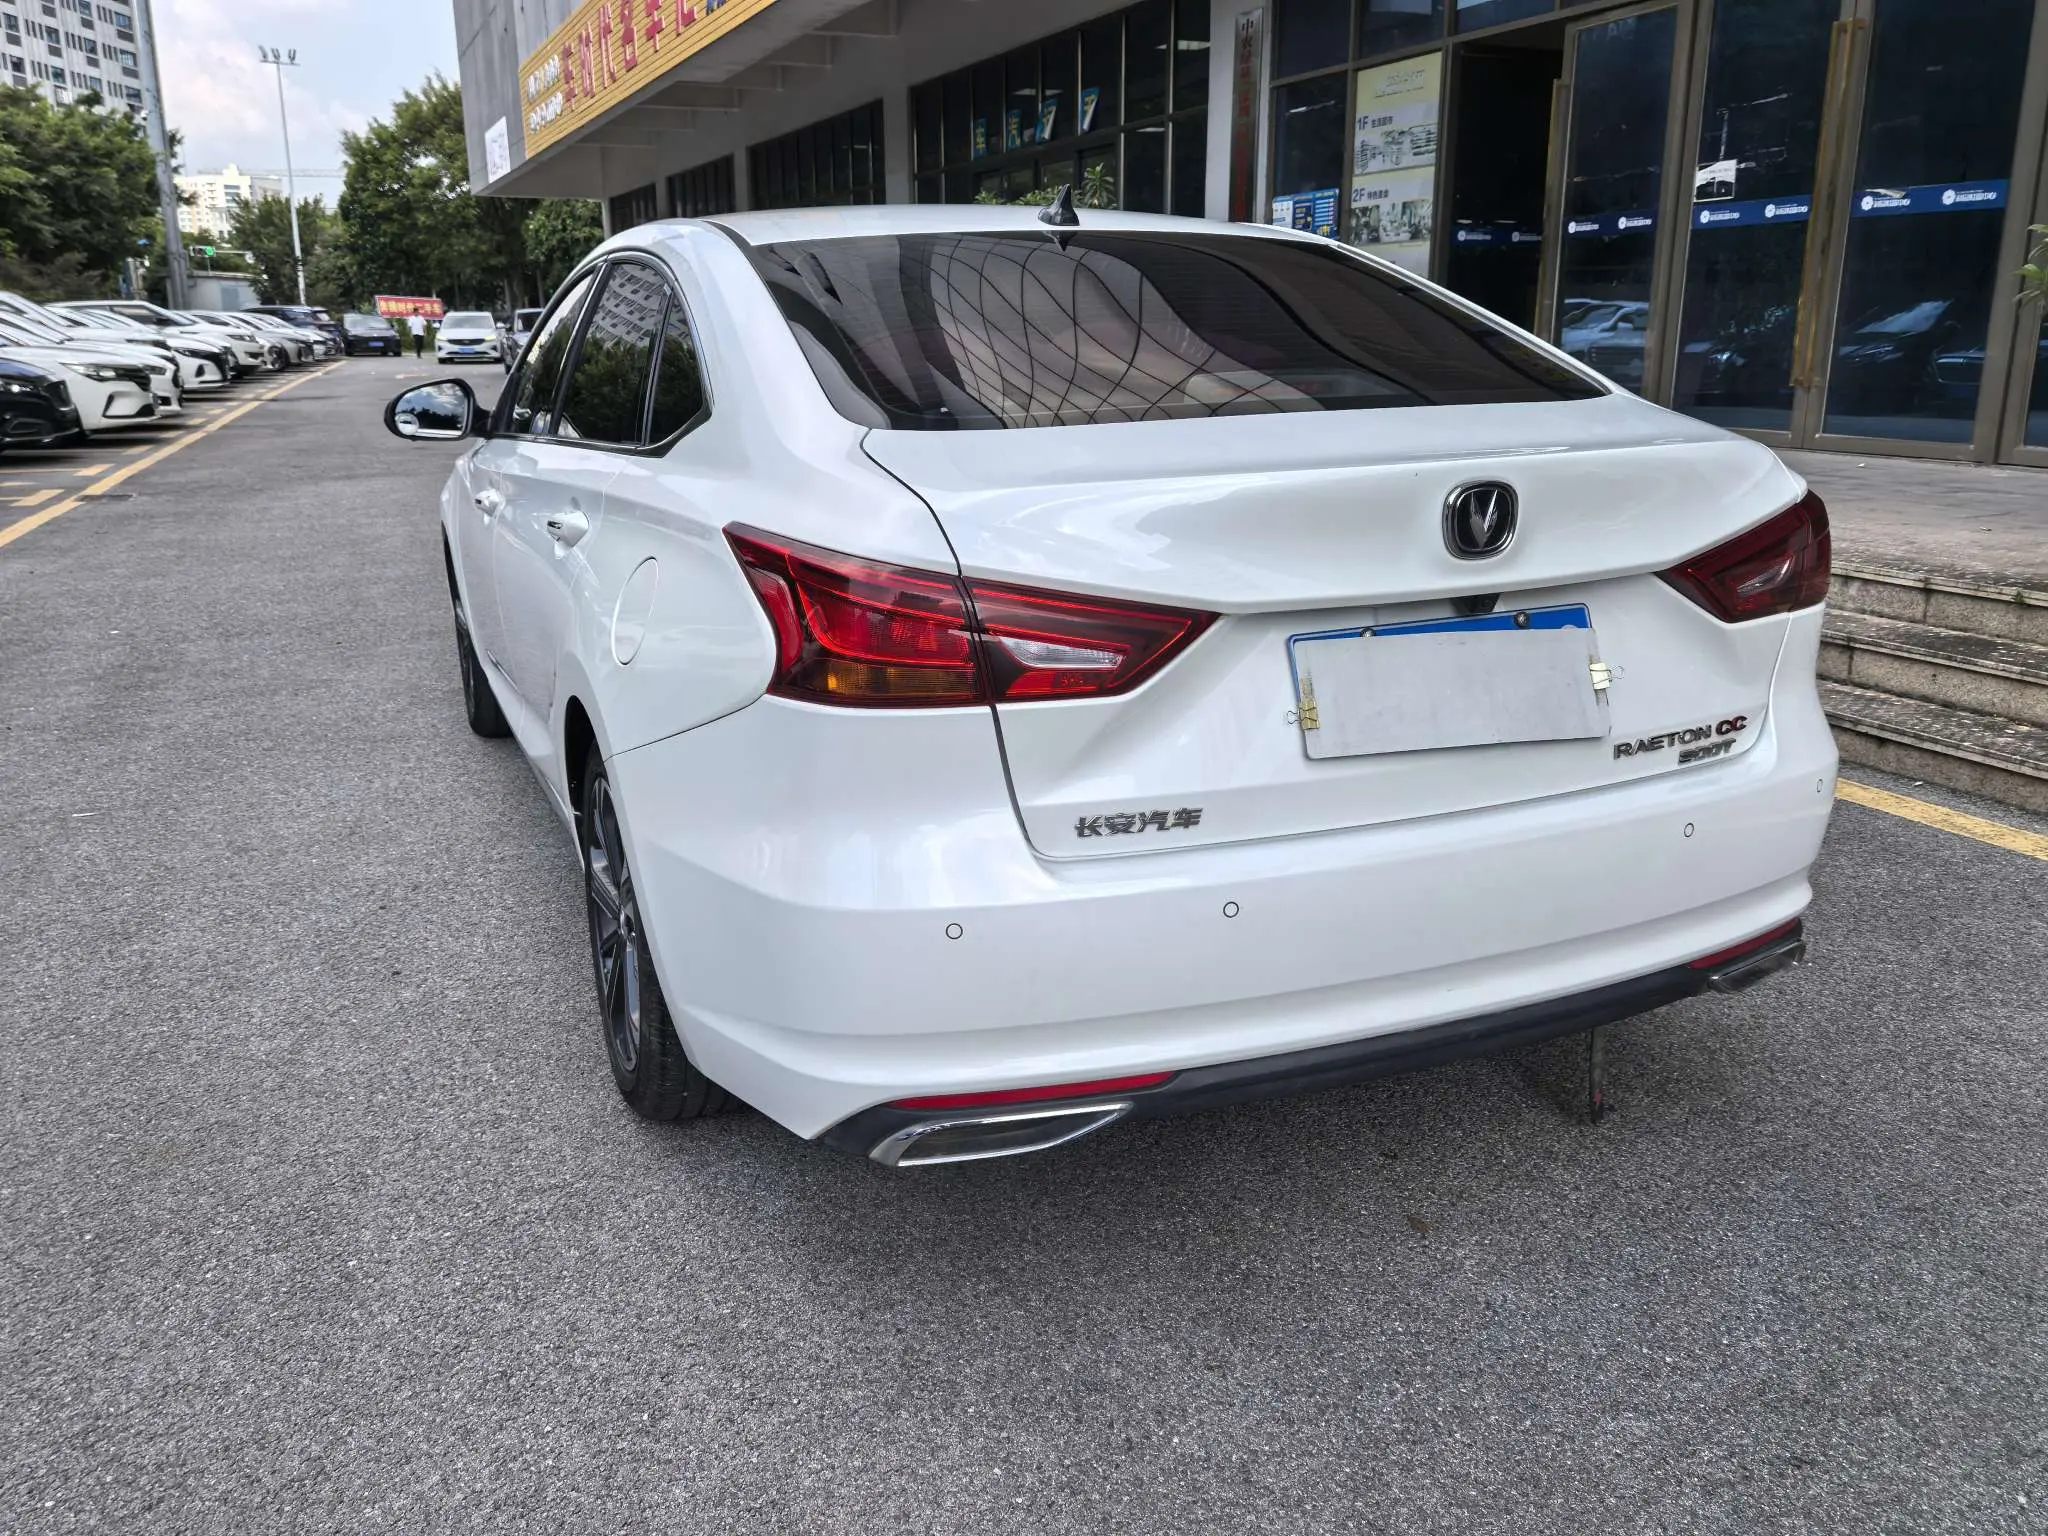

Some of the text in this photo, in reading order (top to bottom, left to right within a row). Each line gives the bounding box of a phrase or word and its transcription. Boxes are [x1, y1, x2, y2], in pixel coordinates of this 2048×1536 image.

[1357, 116, 1368, 130] 1F
[1352, 188, 1365, 202] 2F
[1613, 715, 1748, 760] RAETON CC
[1075, 807, 1203, 838] 长安汽车
